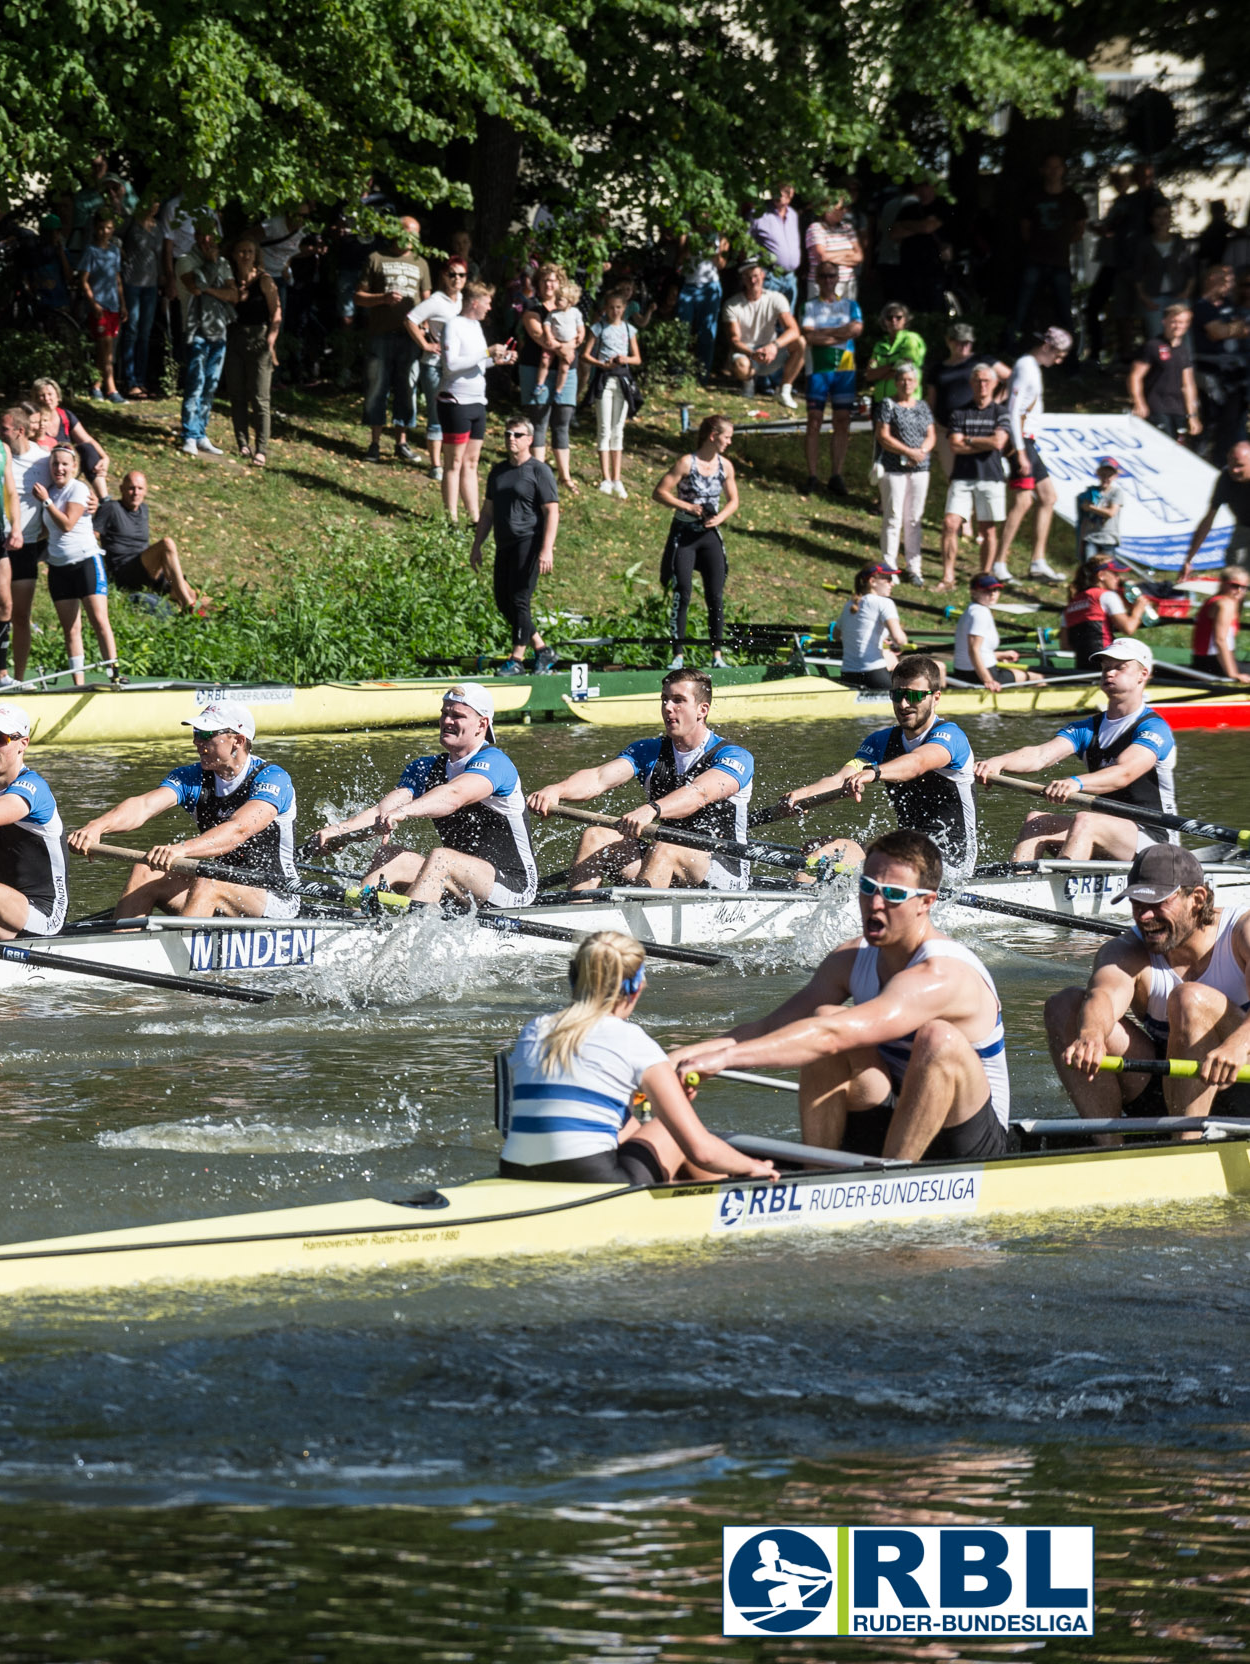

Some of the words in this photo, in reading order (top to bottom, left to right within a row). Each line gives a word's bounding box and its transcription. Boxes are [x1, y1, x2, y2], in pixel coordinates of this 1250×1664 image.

[576, 666, 583, 688] 3
[207, 688, 227, 701] RBL
[230, 689, 293, 701] RUDER-BUNDESLIGA
[284, 879, 325, 898] Melitta
[1081, 874, 1113, 894] RBL
[6, 949, 27, 961] RBL
[192, 928, 313, 970] MINDEN
[749, 1183, 802, 1214] RBL
[809, 1177, 975, 1211] RUDER-BUNDESLIGA
[302, 1237, 369, 1250] Hannoverscher
[370, 1232, 420, 1246] Ruder-Club
[421, 1232, 437, 1242] von
[440, 1230, 460, 1241] 1880
